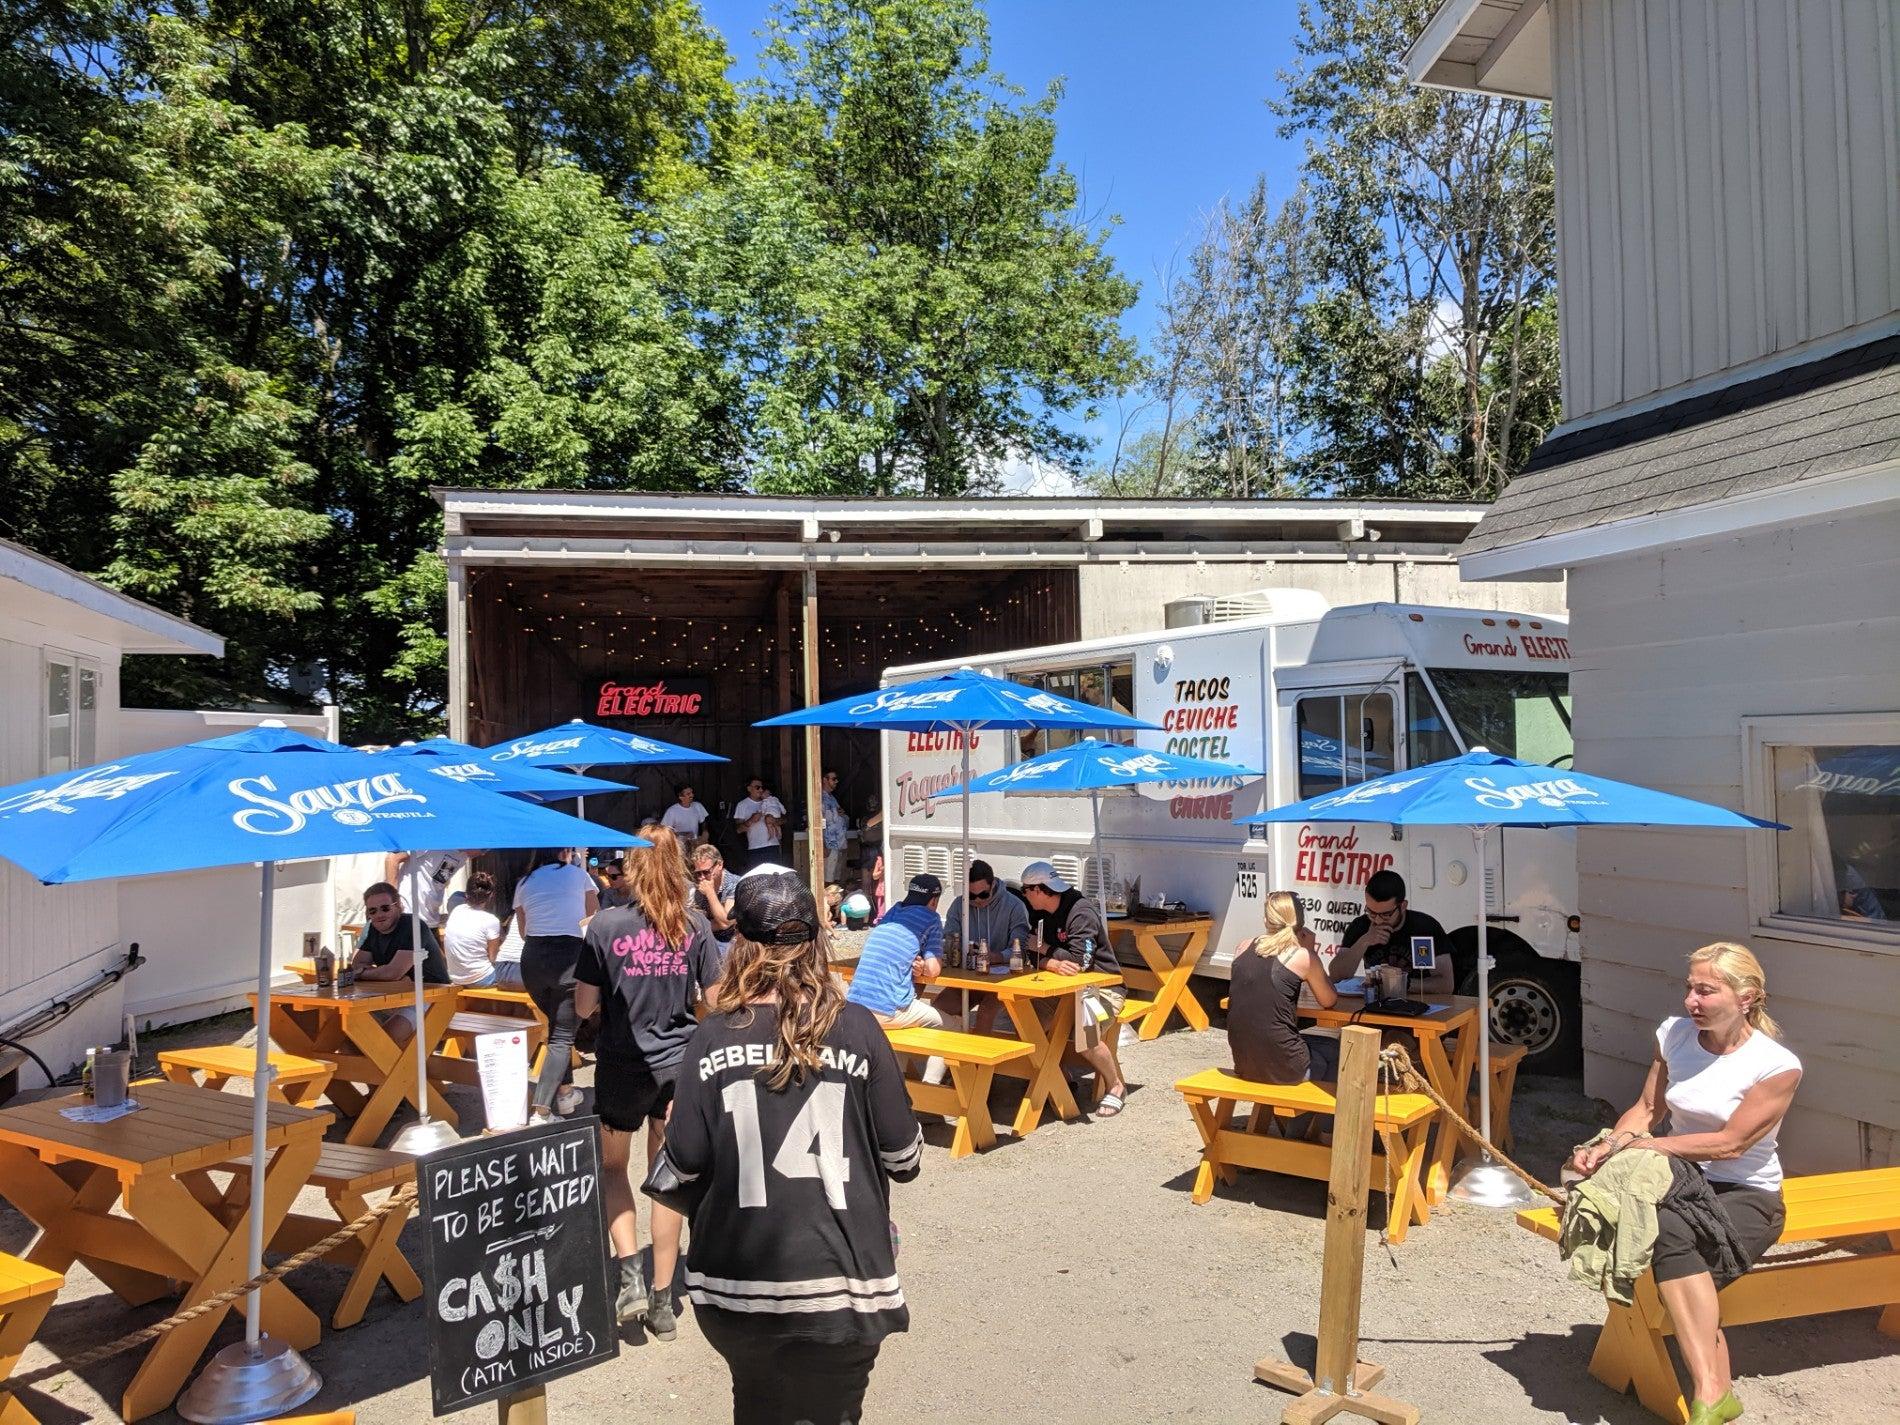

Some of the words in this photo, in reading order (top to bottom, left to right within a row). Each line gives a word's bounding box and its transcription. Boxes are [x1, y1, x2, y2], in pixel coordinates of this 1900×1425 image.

[1464, 633, 1517, 657] Grand
[600, 681, 667, 699] Grand
[1175, 677, 1230, 703] TACOS
[597, 693, 702, 716] ELECTRIC
[1163, 705, 1238, 734] CEVICHE
[1166, 736, 1231, 760] COCTEL
[228, 774, 427, 836] Sauza
[1464, 777, 1599, 810] Sauza
[374, 811, 437, 819] TEQUILA
[1170, 794, 1234, 820] CARNE
[1298, 825, 1359, 850] Grand
[1236, 873, 1257, 898] 1525
[1327, 900, 1362, 915] QUEEN
[624, 965, 652, 977] WAS
[655, 965, 688, 977] HERE
[632, 951, 686, 969] ROSES
[699, 1044, 783, 1082] REBEL
[721, 1079, 850, 1210] 14
[435, 1153, 519, 1201] PLEASE
[529, 1139, 585, 1179] WAIT
[433, 1210, 468, 1243] TO
[477, 1197, 504, 1235] BE
[514, 1173, 595, 1223] SEATED
[438, 1249, 550, 1323] CA$H
[475, 1284, 584, 1360] ONLY
[460, 1361, 517, 1395] (ATM
[529, 1330, 596, 1371] INSIDE)
